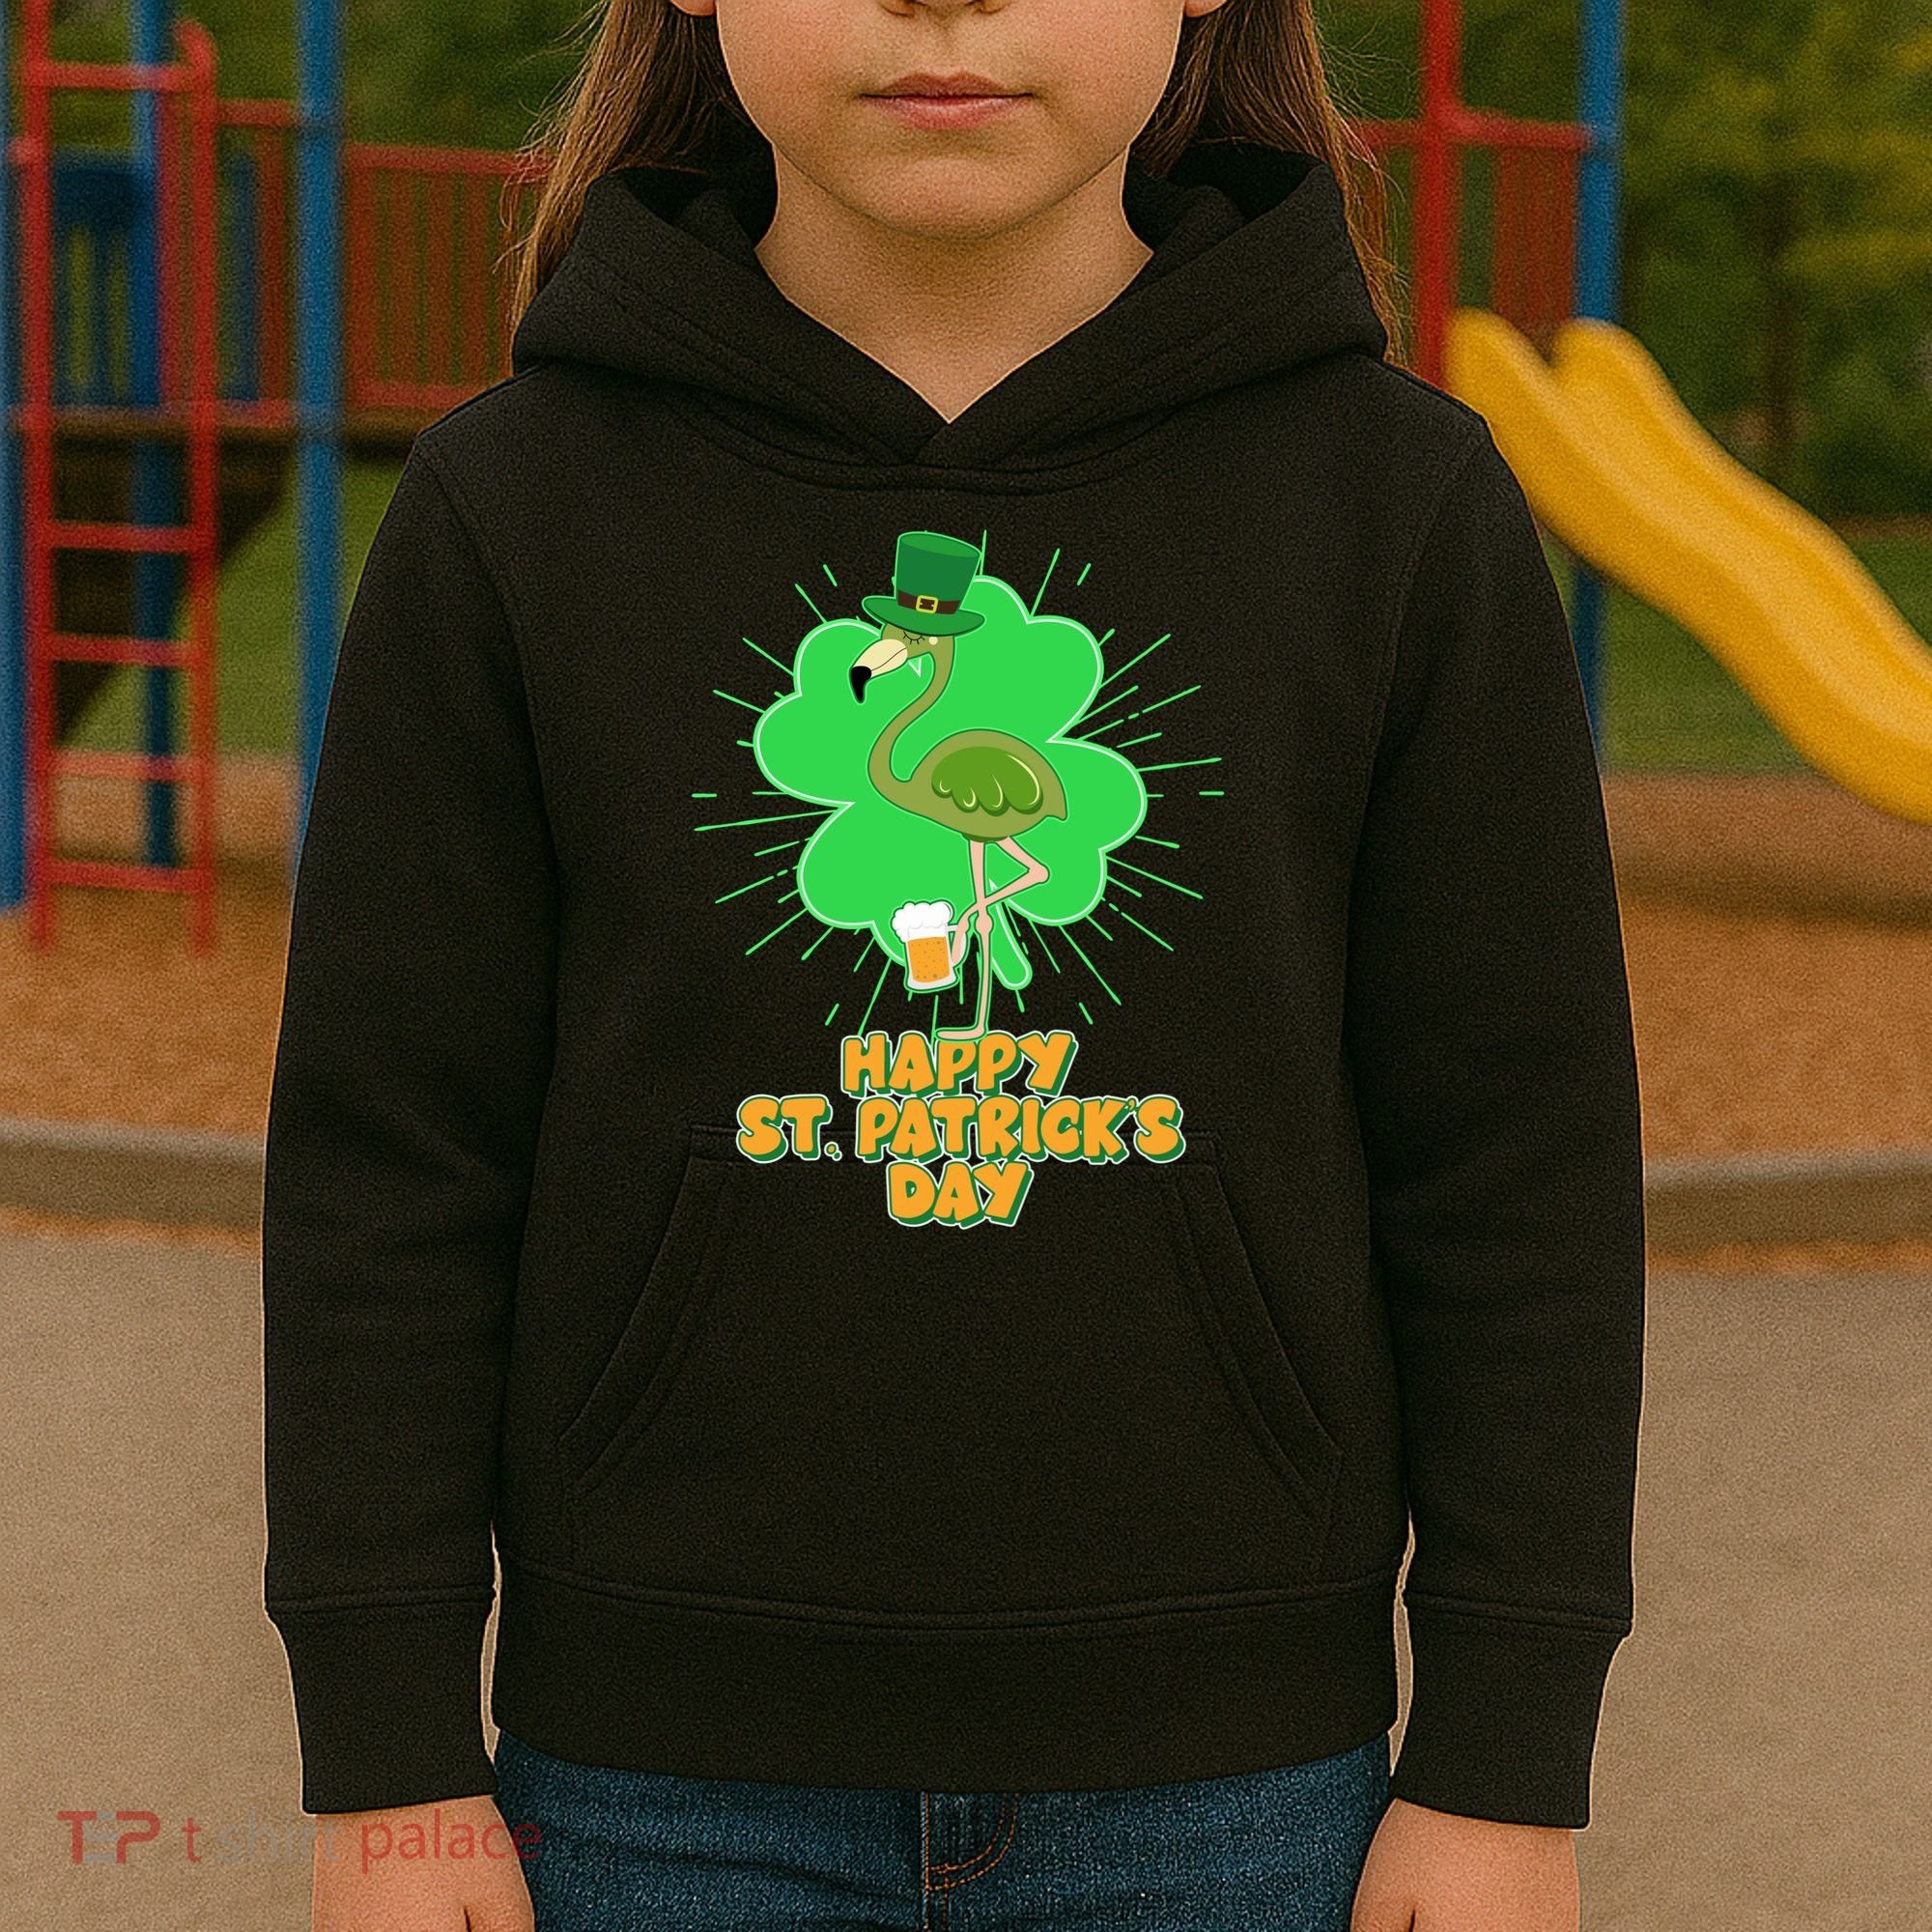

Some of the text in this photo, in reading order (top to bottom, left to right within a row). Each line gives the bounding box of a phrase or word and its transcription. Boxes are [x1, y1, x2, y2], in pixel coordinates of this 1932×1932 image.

[840, 1030, 1078, 1097] HAPPY
[736, 1094, 1186, 1165] ST. PATRICK'S
[886, 1158, 1035, 1230] DAY
